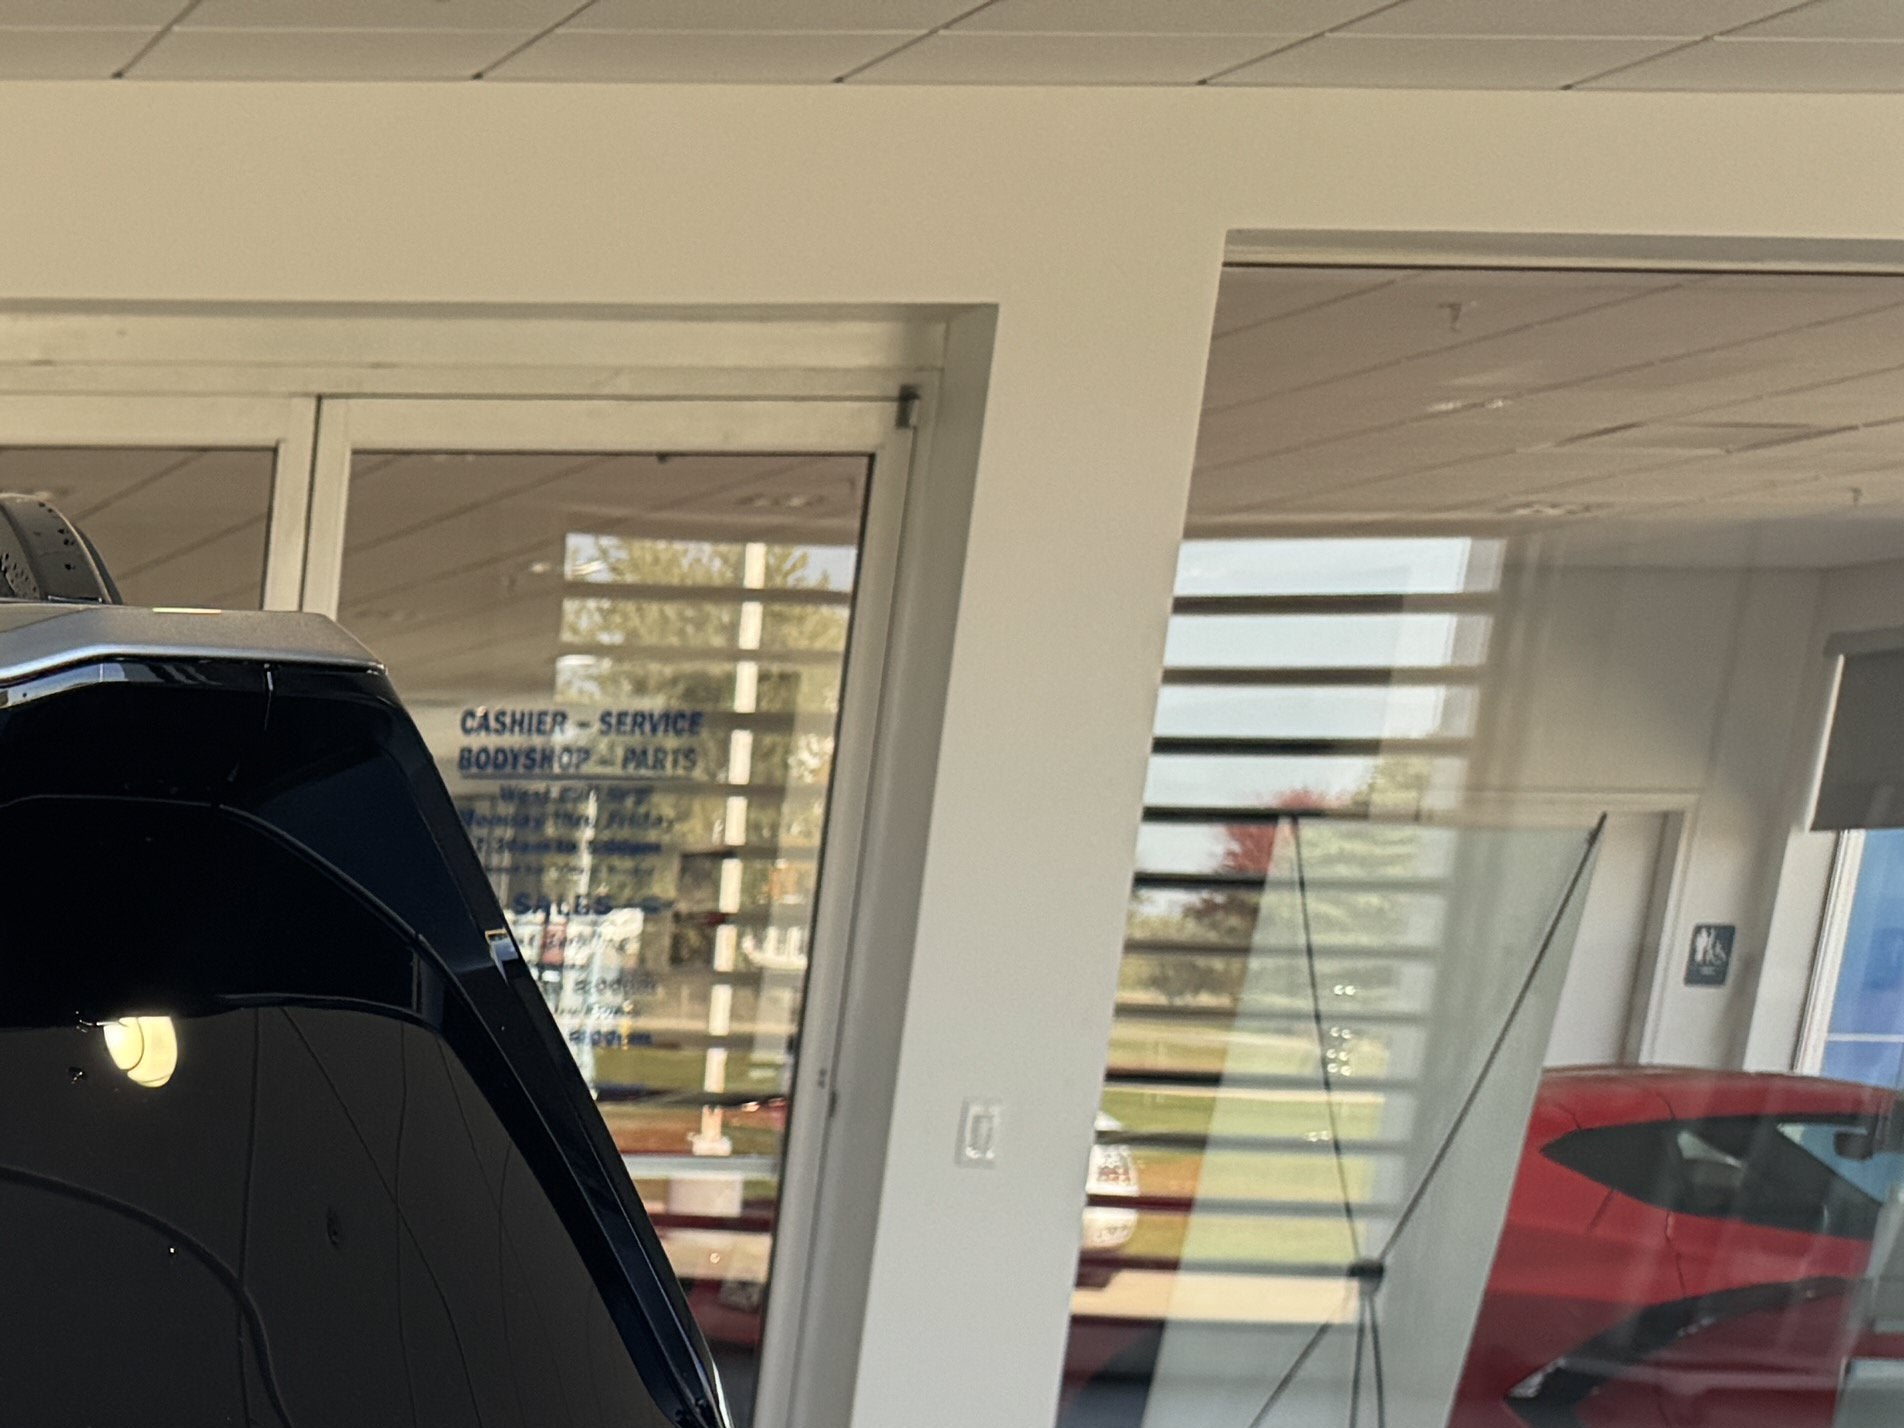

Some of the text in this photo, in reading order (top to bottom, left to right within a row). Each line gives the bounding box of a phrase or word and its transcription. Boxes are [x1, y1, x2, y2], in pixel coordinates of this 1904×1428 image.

[460, 709, 568, 736] CASHIER
[599, 710, 704, 736] SERVICE
[458, 746, 593, 772] BODYSHOP
[621, 746, 697, 771] PARTS
